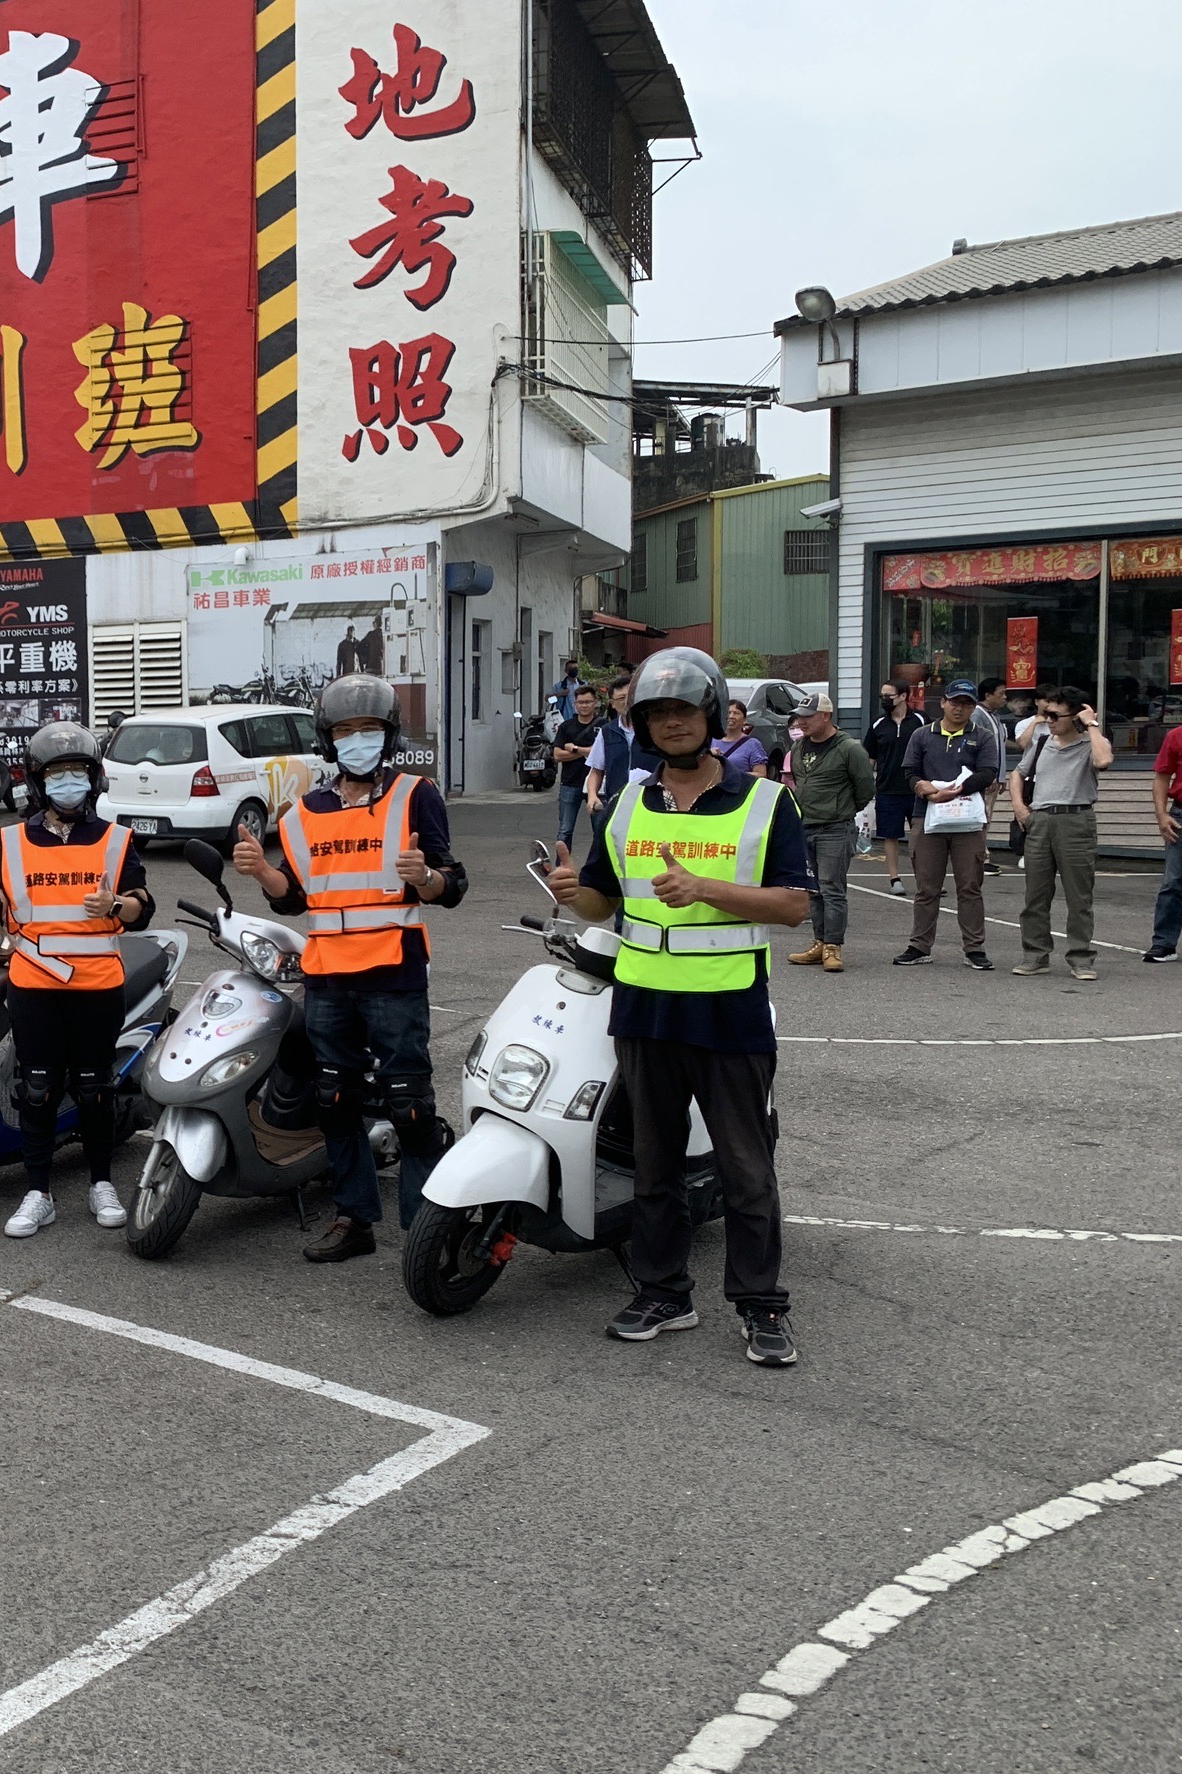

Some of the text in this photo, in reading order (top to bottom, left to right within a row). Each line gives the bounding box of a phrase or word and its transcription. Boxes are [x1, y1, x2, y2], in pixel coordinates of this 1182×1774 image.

[338, 22, 476, 463] 地考照
[0, 568, 43, 582] YAMAHA
[227, 563, 304, 585] Kawasaki
[310, 555, 426, 580] 原廠授權經銷商
[193, 588, 271, 610] 祐昌車業
[26, 605, 69, 623] YMS
[52, 627, 75, 635] SHOP
[391, 750, 434, 765] 8089
